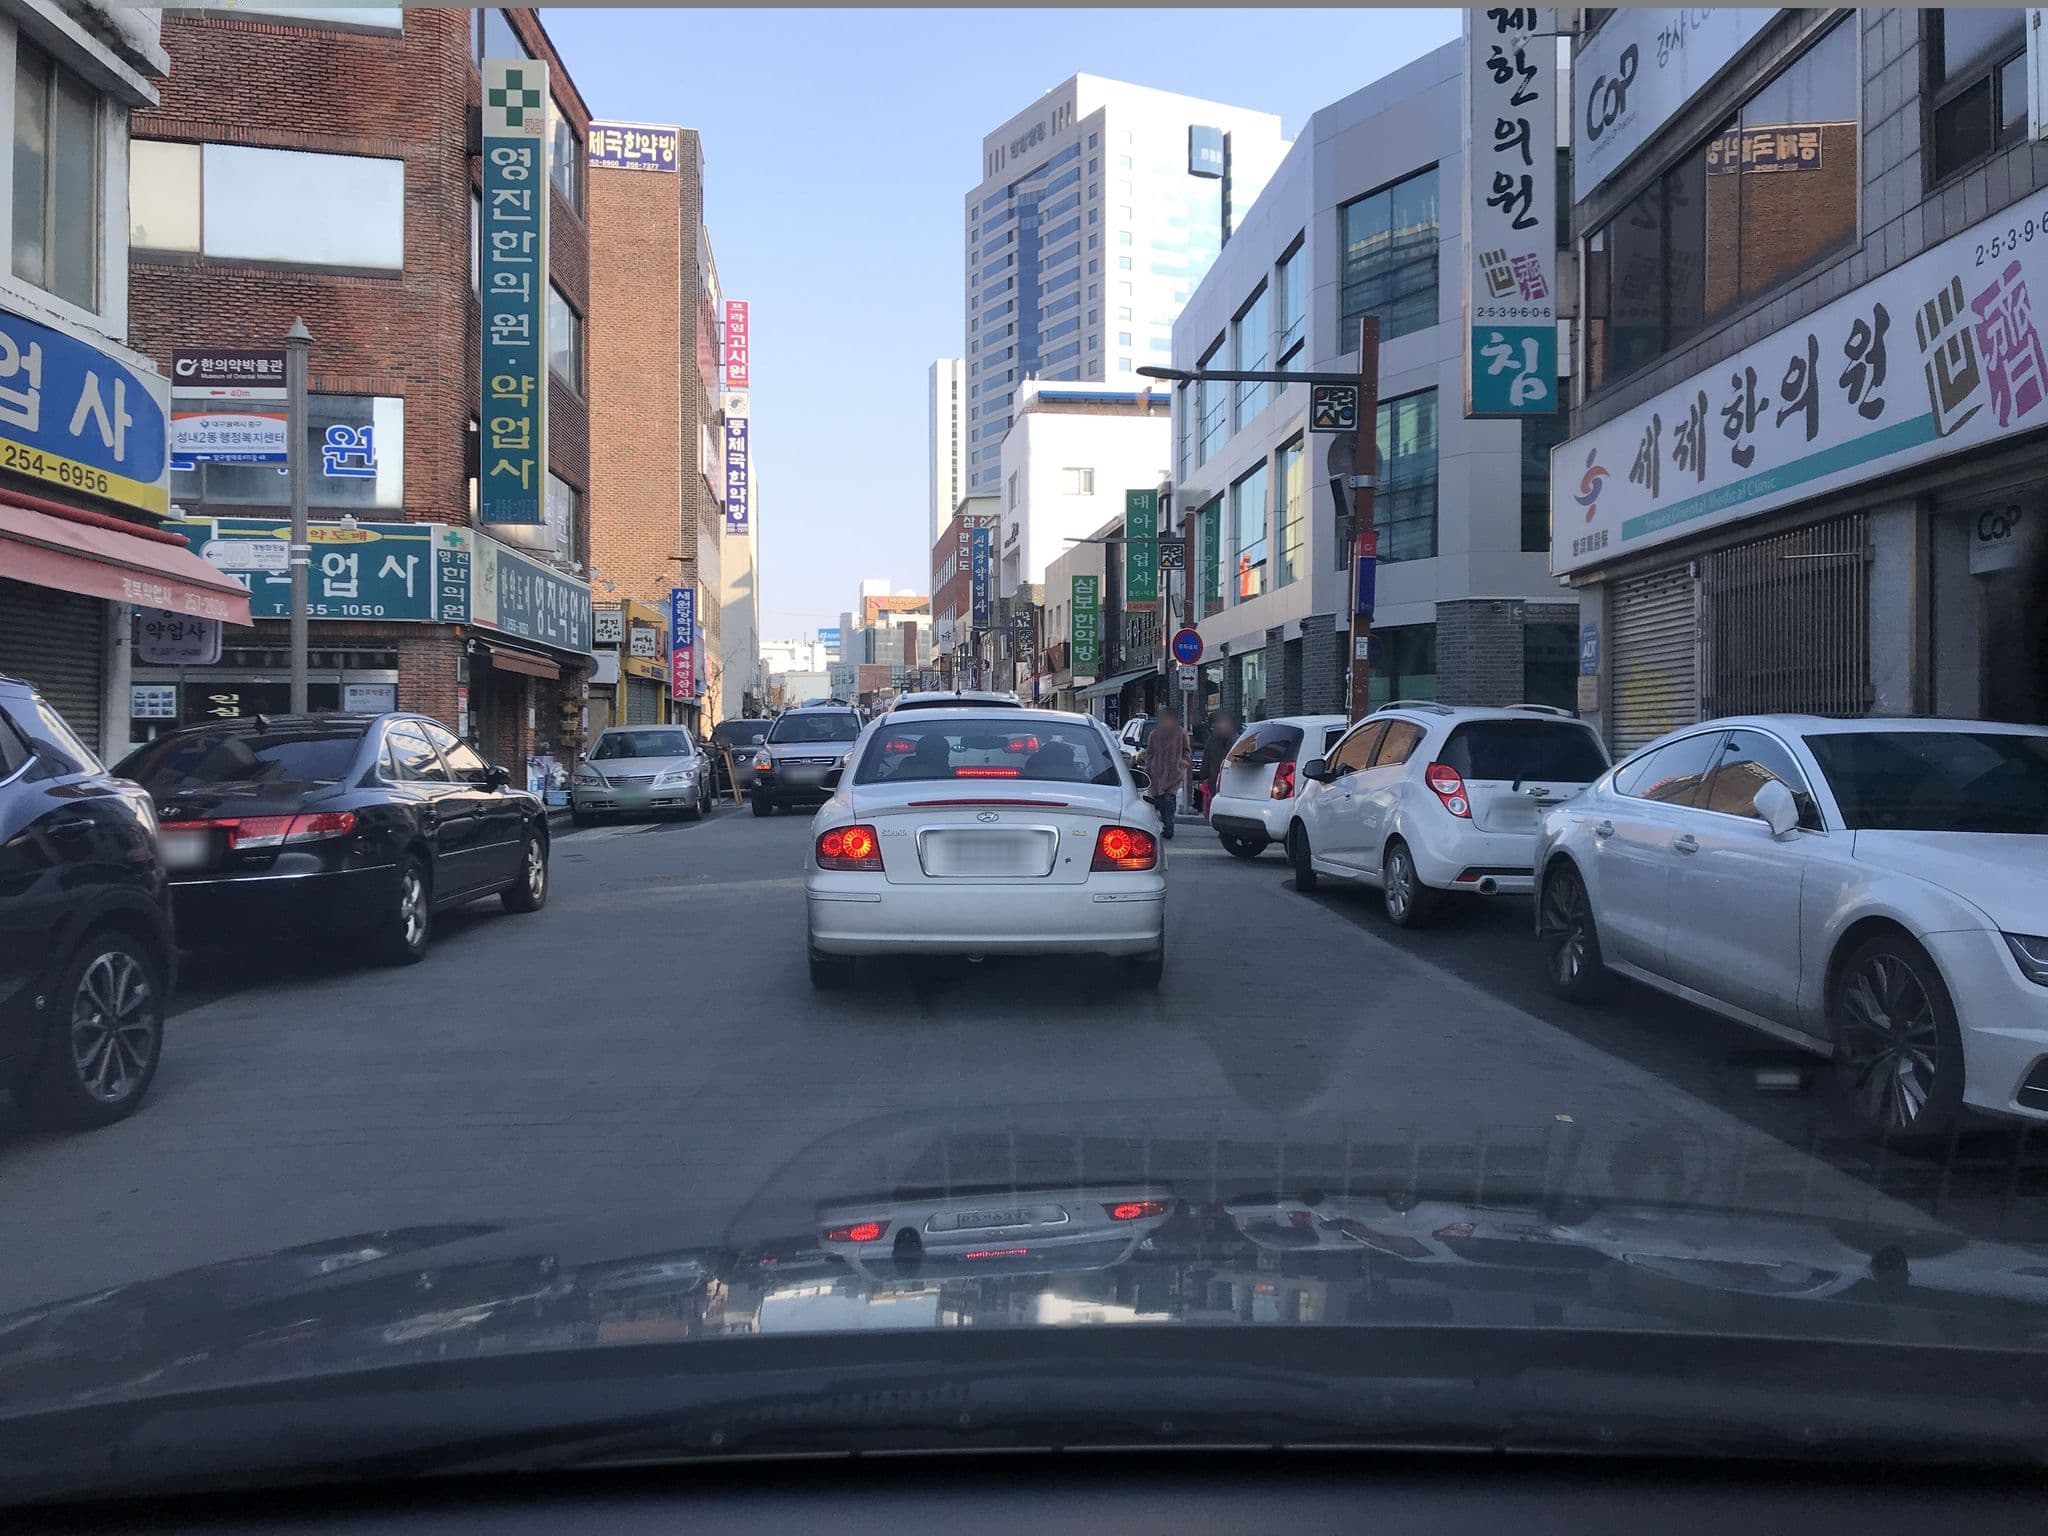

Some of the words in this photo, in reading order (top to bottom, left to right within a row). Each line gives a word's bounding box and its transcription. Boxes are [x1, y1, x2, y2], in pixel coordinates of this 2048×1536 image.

[729, 303, 746, 379] 프라임고시원
[201, 358, 283, 373] 한의약박물관
[1480, 332, 1547, 407] 침
[230, 389, 251, 398] 40m
[1629, 302, 1890, 500] 세제한의원
[177, 431, 217, 444] 성내2동
[219, 431, 285, 444] 행정복지센터
[212, 420, 246, 428] 대구광역시
[248, 420, 262, 429] 중구
[5, 445, 108, 493] 254-6956
[727, 420, 746, 520] 동제국한약방
[974, 534, 988, 613] 신광약업사
[273, 602, 385, 617] T.55-1050
[535, 575, 589, 646] 영진약업사
[1074, 577, 1097, 663] 삼보한약방
[146, 621, 206, 642] 약업사
[1178, 641, 1199, 650] 주차금지
[1582, 639, 1596, 660] ADT
